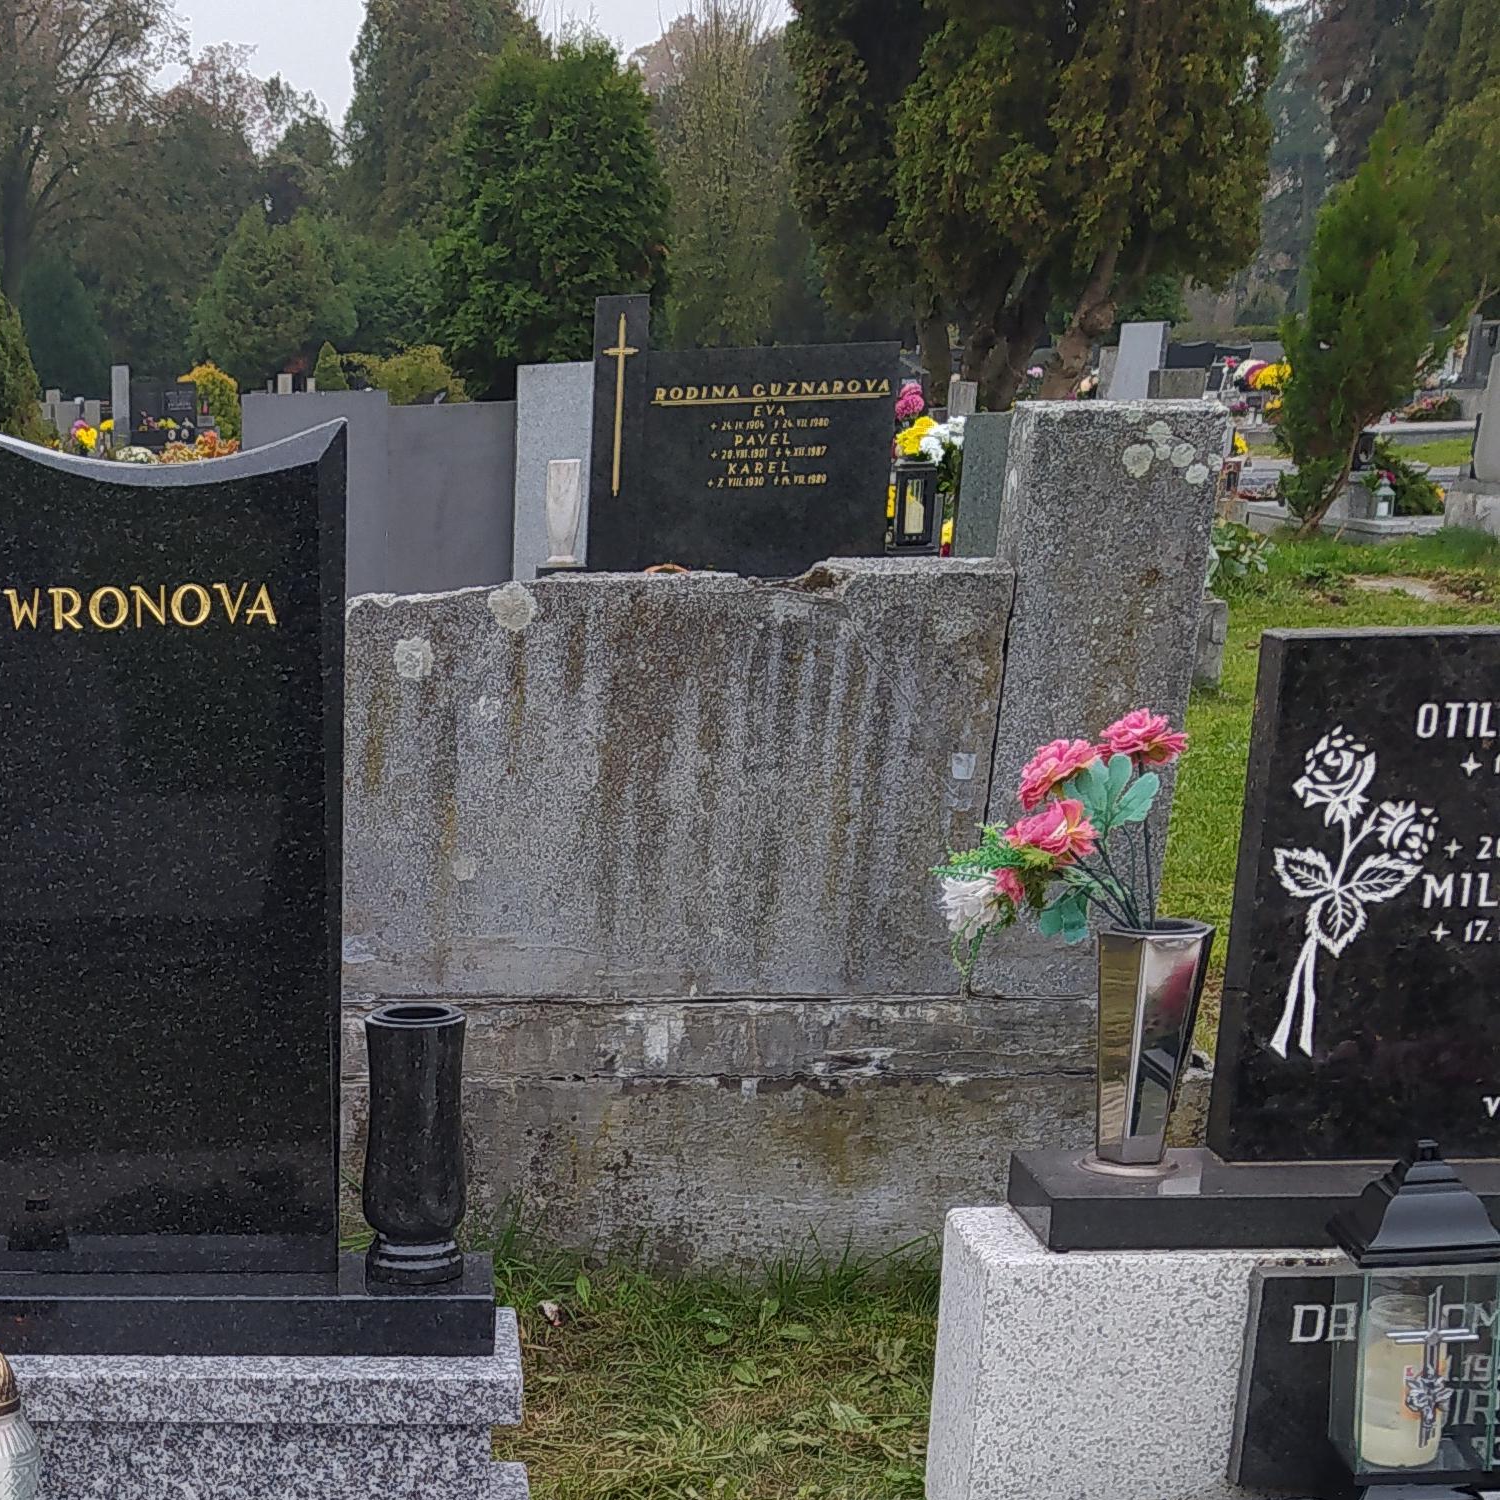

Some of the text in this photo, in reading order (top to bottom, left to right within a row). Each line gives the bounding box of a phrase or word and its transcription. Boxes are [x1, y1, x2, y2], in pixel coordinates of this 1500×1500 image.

[655, 384, 740, 402] RODINA
[753, 404, 787, 418] EVA
[734, 433, 791, 447] PAVEL
[727, 461, 790, 475] KAREL
[3, 582, 278, 631] WRONOVA
[1416, 702, 1500, 739] OTIL
